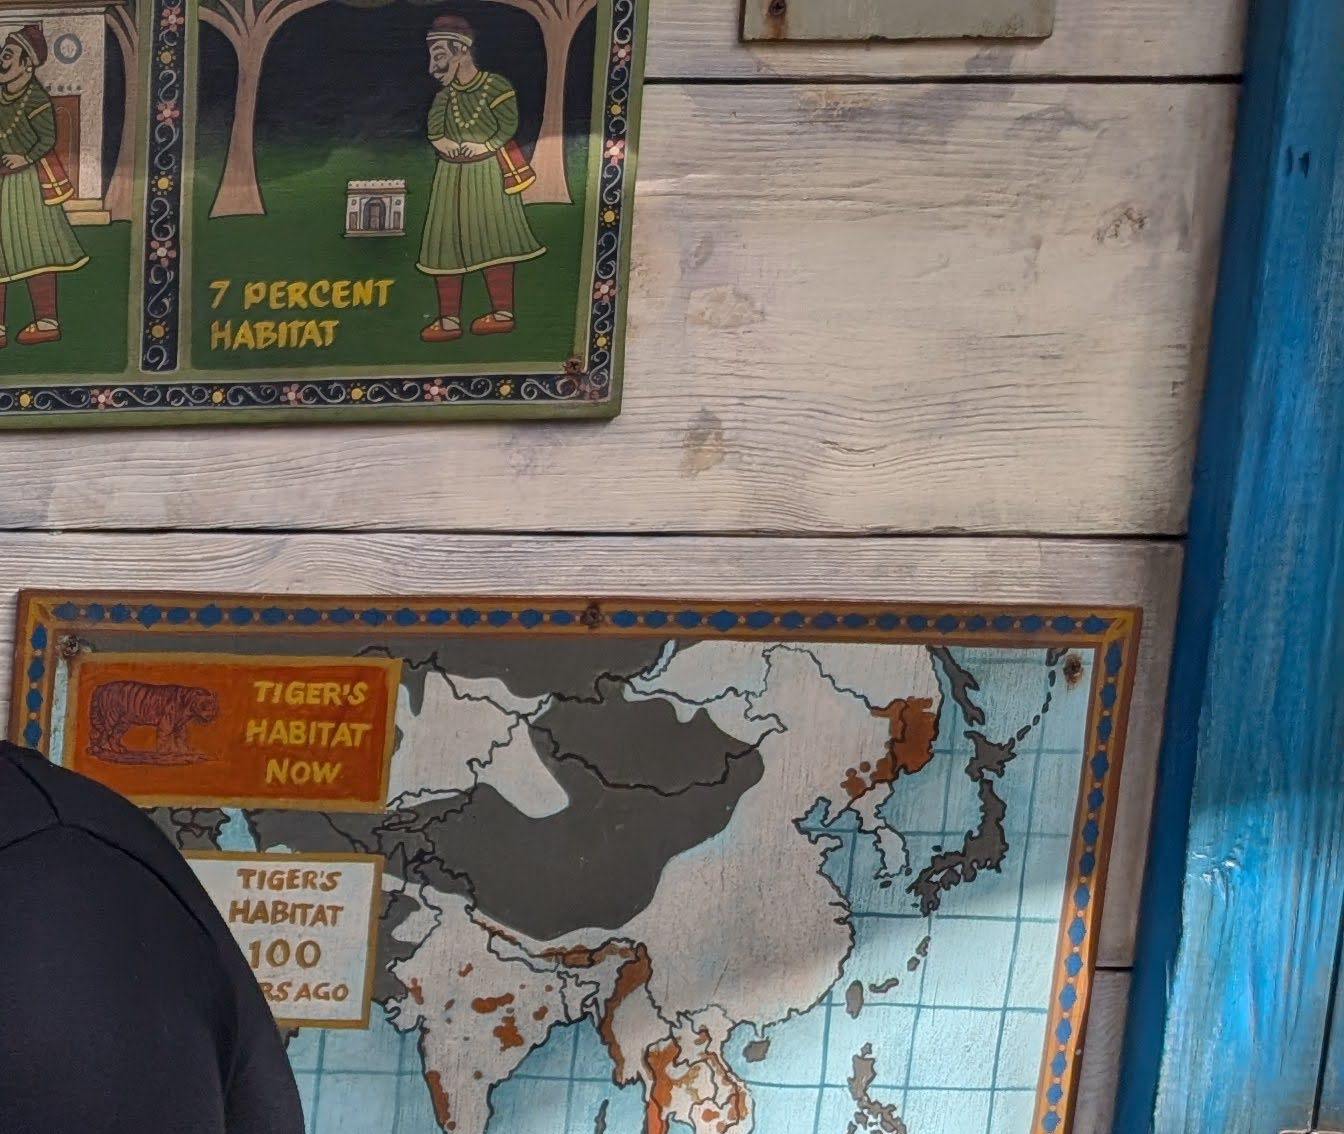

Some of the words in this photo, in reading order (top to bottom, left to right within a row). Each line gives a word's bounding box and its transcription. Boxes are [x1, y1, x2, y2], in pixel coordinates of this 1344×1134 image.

[209, 280, 231, 309] 7
[244, 279, 396, 310] PERCENT
[210, 319, 340, 351] HABITAT
[252, 680, 369, 707] TIGER'S
[244, 719, 372, 749] HABITAT
[265, 758, 342, 786] NOW
[236, 868, 343, 892] TIGER'S
[228, 899, 345, 927] HABITAT
[248, 938, 322, 970] 100
[293, 982, 349, 1002] AGO
